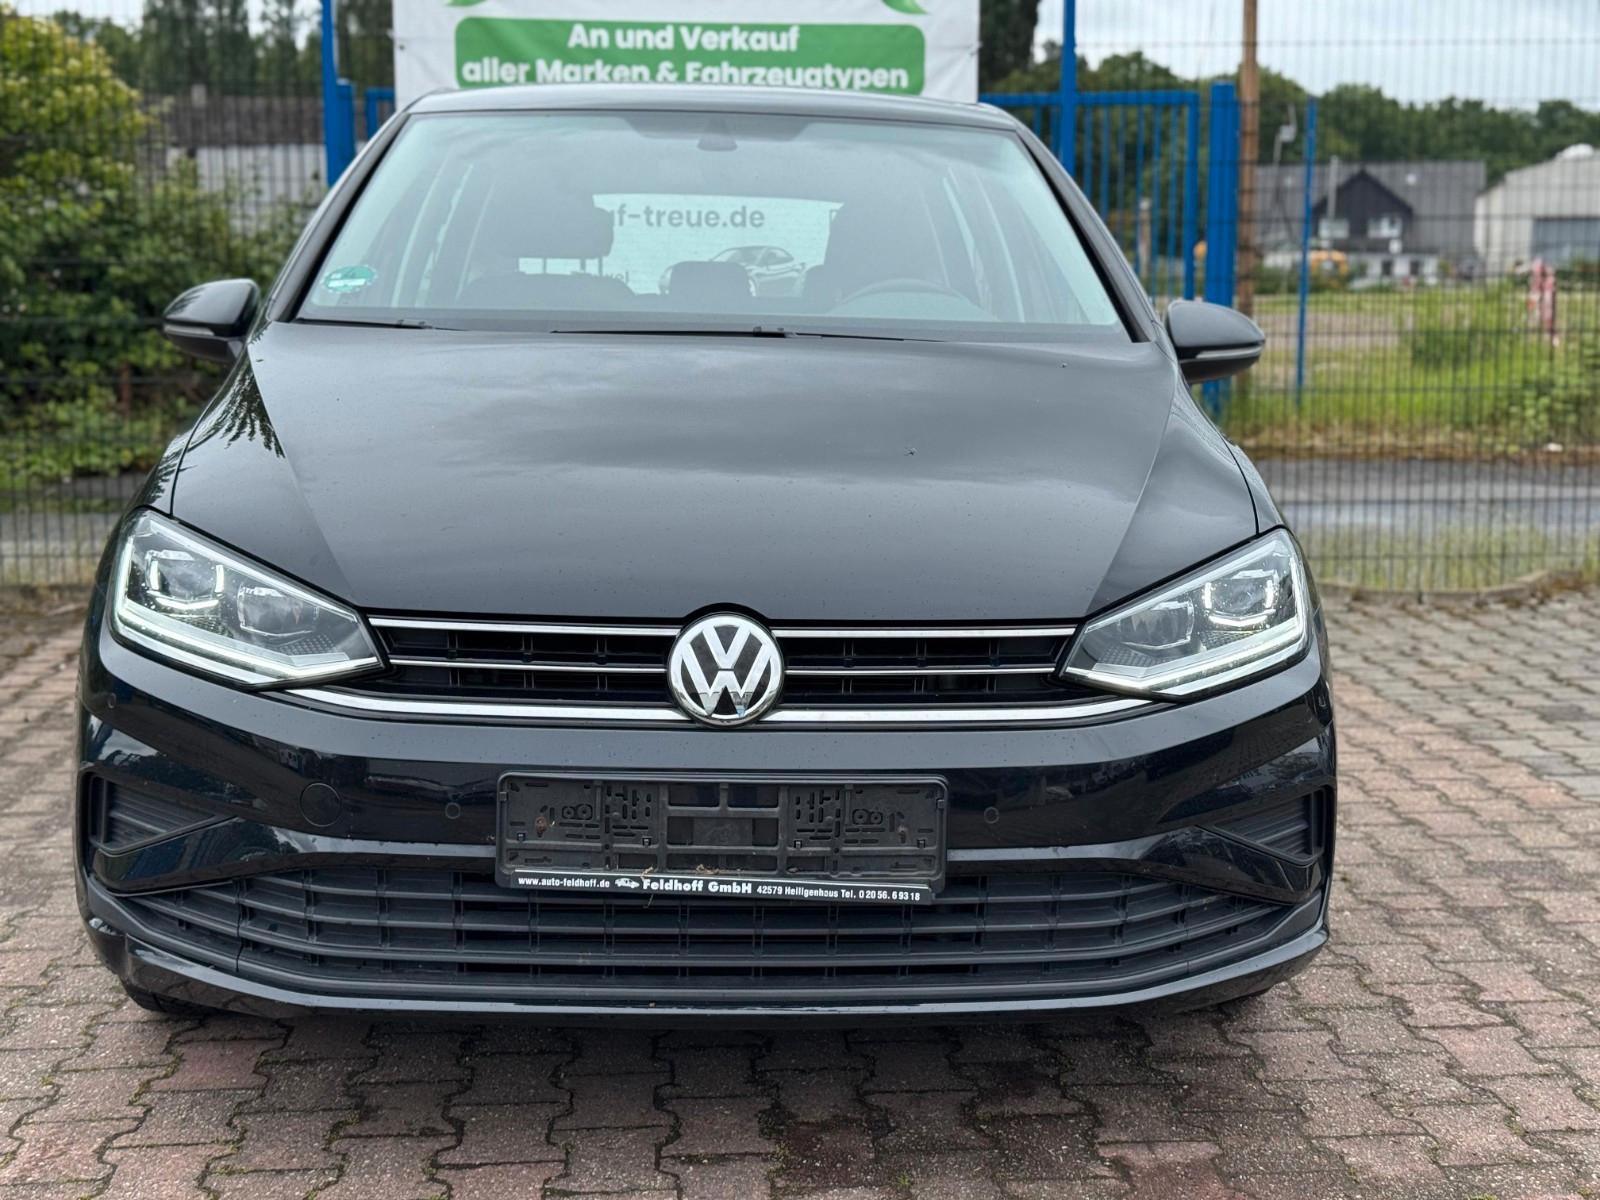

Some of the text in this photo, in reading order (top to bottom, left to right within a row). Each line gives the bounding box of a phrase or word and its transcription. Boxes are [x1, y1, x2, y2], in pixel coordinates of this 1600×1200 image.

[567, 23, 800, 52] An und Verkauf
[462, 57, 530, 83] aller
[535, 59, 650, 83] Marken
[655, 61, 679, 82] &
[671, 614, 783, 722] VW
[518, 877, 610, 888] www.auto-feldhoff.de
[642, 879, 704, 892] Feldhoff
[708, 881, 752, 894] GmbH
[757, 885, 783, 895] 42579
[785, 886, 839, 898] Heiligenhaus
[841, 889, 856, 899] Tel.
